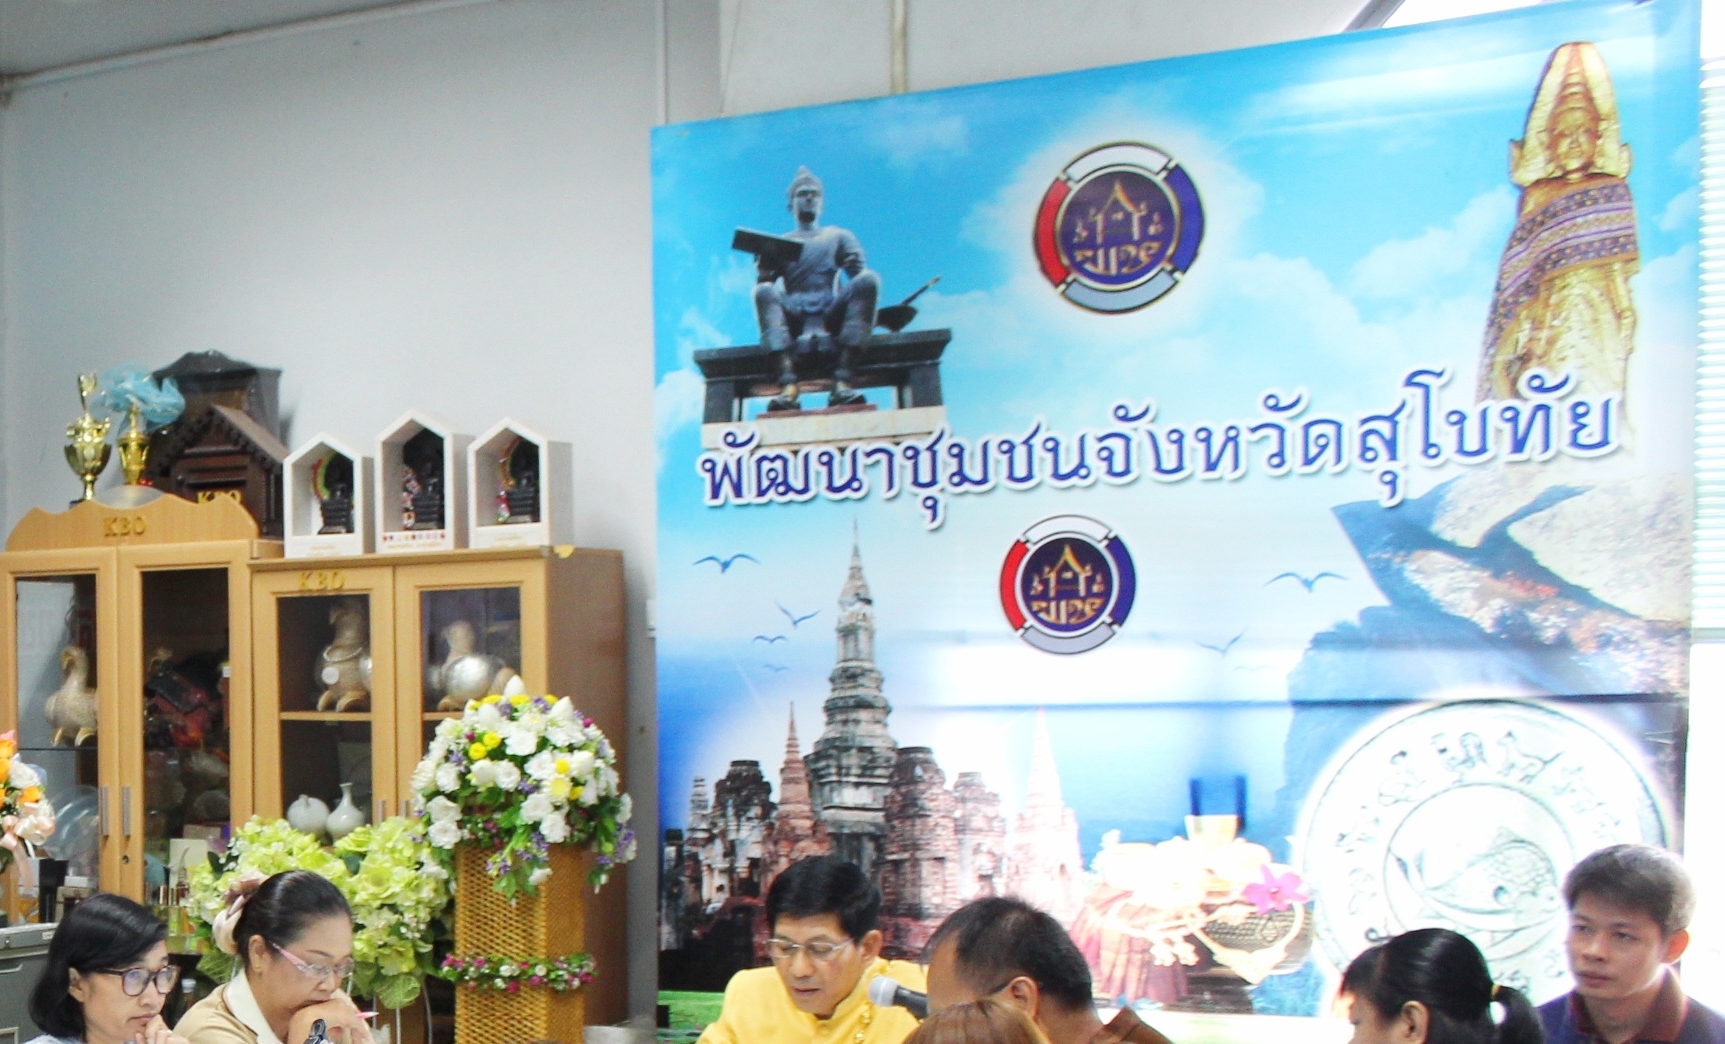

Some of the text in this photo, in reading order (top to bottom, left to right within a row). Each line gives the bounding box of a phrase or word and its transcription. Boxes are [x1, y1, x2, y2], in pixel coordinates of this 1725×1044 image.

[197, 490, 242, 504] KO
[104, 517, 147, 537] KBO
[299, 571, 346, 591] KBO
